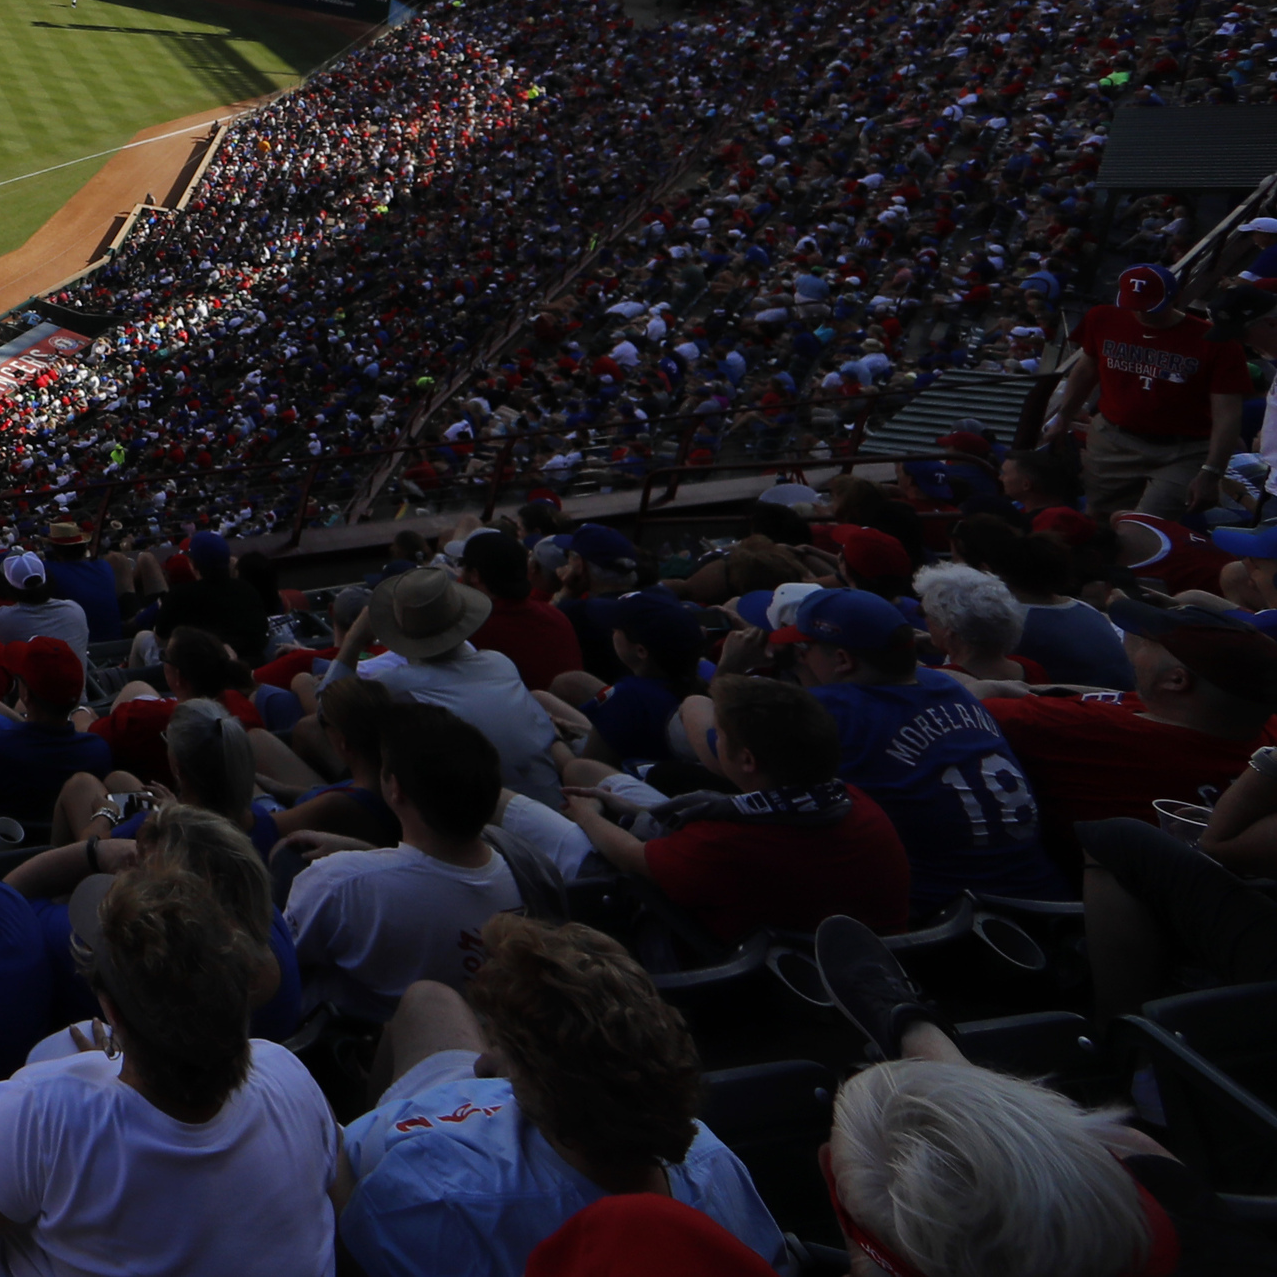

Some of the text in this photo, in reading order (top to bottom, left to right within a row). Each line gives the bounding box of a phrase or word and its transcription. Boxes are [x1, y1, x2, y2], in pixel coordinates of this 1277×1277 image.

[1129, 278, 1147, 293] T
[1101, 338, 1200, 376] RANGERS
[1106, 357, 1160, 379] BASEBALL
[1138, 375, 1153, 391] T
[884, 701, 1001, 767] MORELAND
[940, 752, 1038, 847] 18
